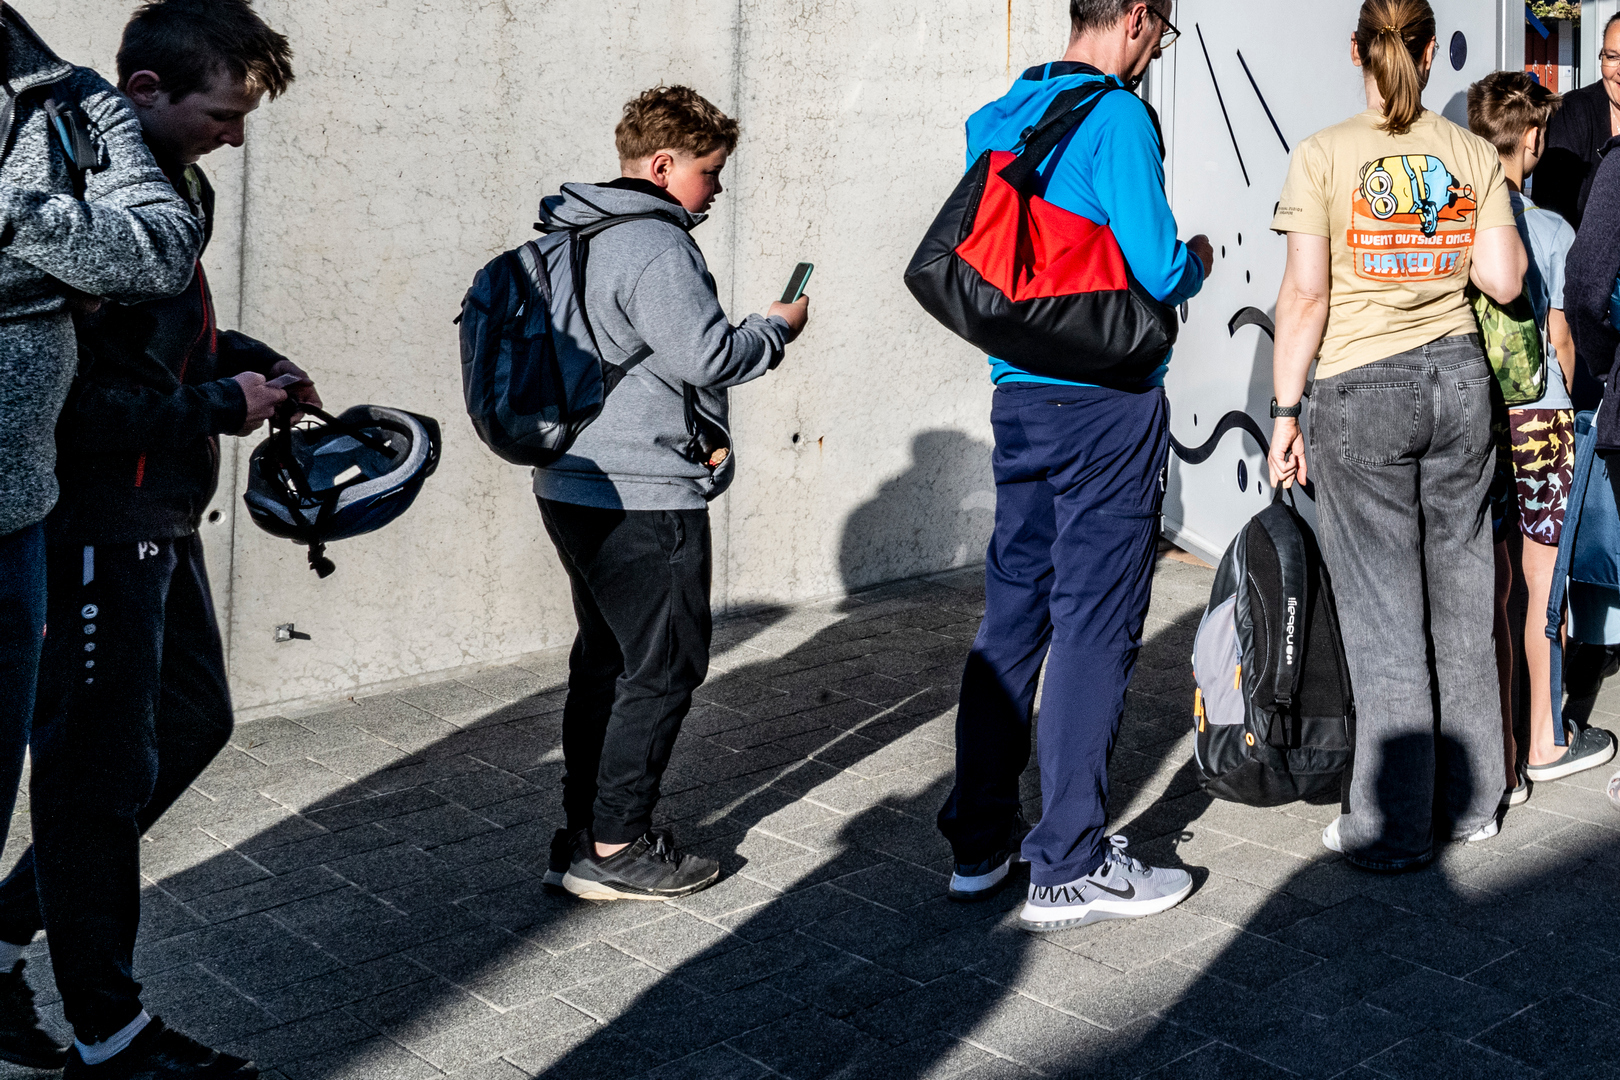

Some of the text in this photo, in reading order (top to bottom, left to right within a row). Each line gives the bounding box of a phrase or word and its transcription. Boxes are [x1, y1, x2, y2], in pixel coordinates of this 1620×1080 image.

[1353, 233, 1472, 246] I WENT OUTSIDE ONCE,
[1363, 251, 1460, 276] HATED IT
[1032, 884, 1087, 903] MAX
